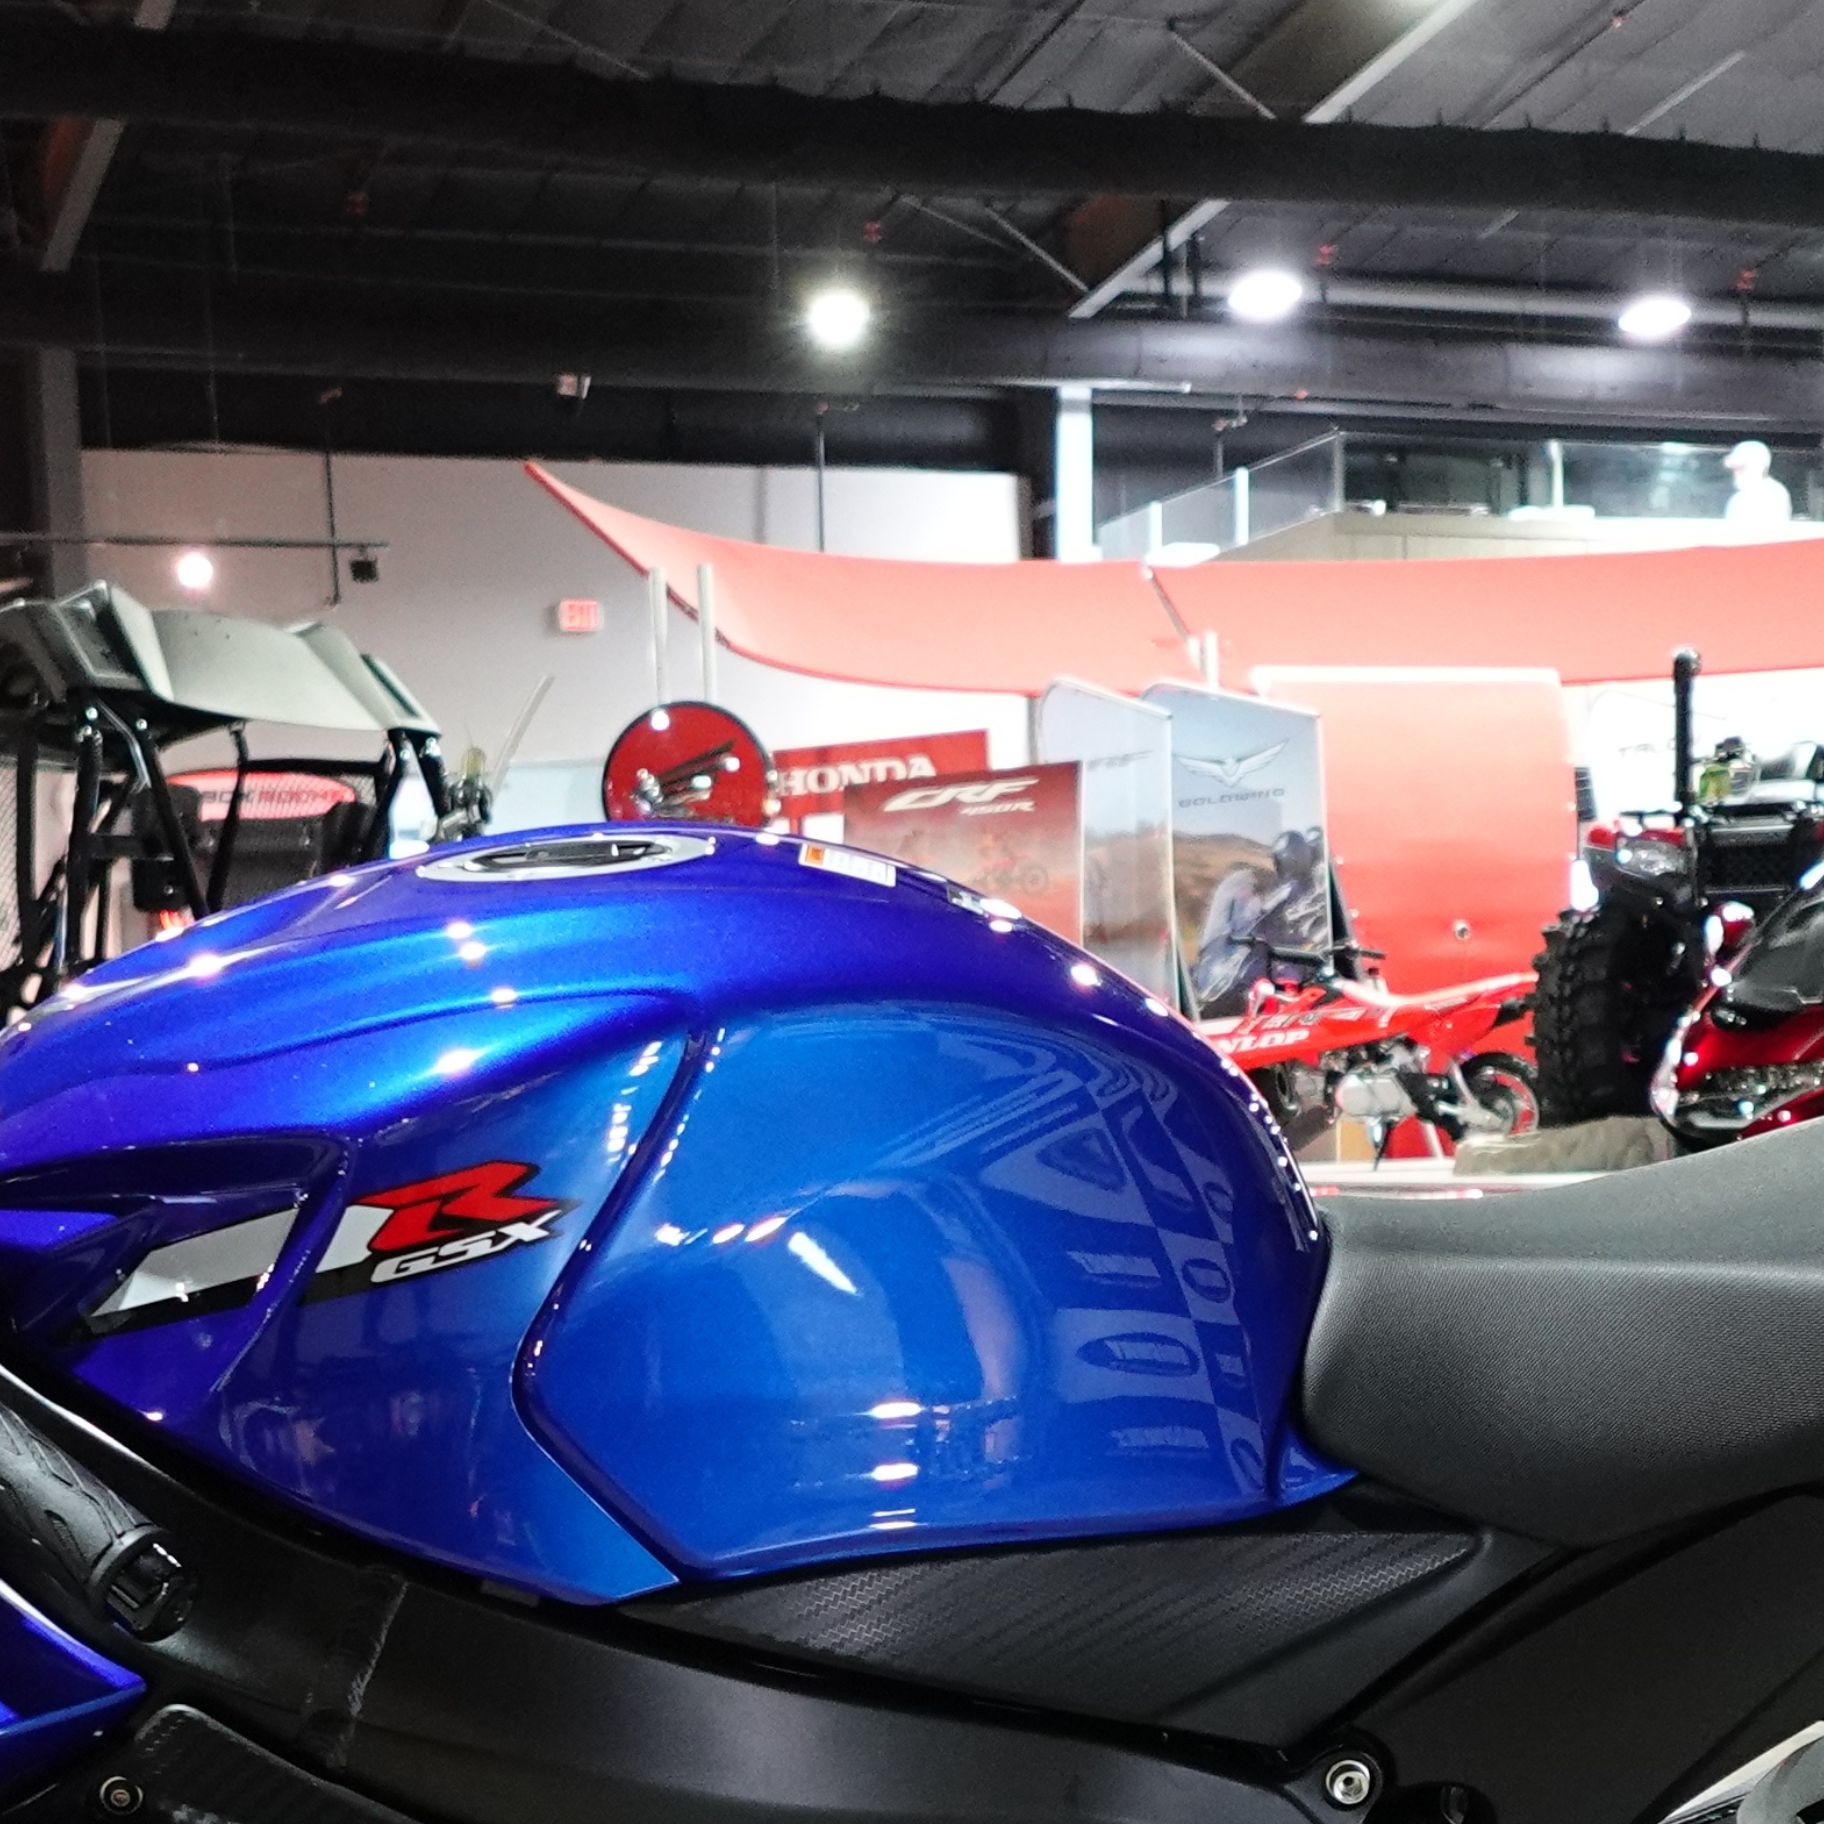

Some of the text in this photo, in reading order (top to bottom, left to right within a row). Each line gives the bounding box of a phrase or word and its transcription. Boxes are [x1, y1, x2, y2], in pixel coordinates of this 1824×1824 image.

[775, 753, 937, 797] HONDA
[883, 777, 1040, 813] CRF
[370, 1210, 562, 1283] GSX
